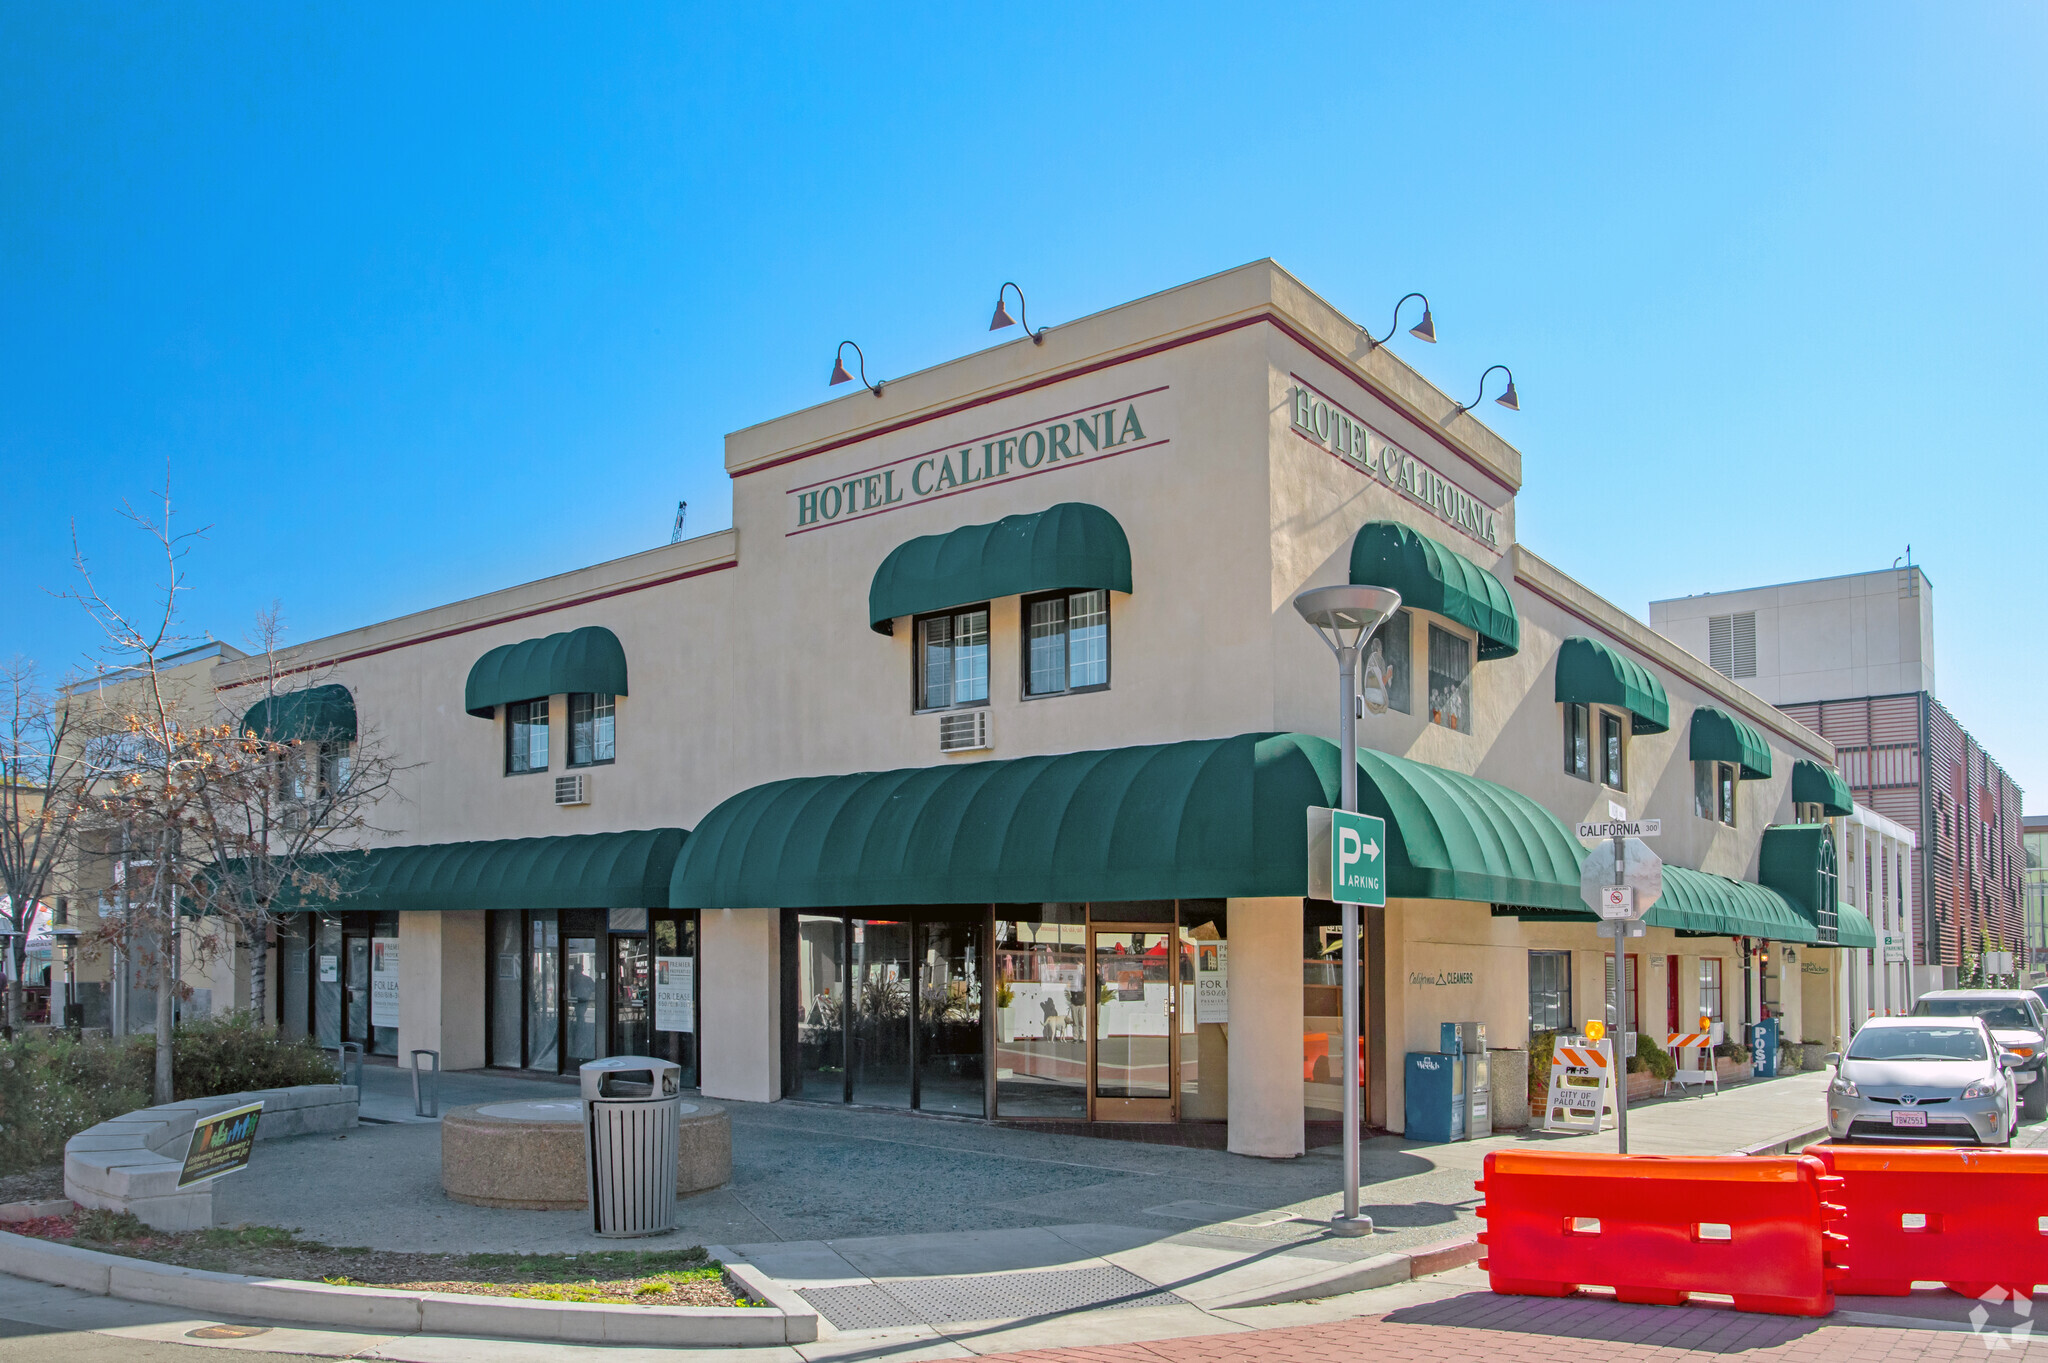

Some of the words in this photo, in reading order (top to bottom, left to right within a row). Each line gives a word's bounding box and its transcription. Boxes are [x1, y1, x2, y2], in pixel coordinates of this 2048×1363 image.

[797, 470, 903, 527] HOTEL
[911, 403, 1147, 497] CALIFORNIA
[1295, 385, 1378, 473] HOTEL
[1383, 444, 1499, 547] CALIFORNIA
[1580, 823, 1640, 837] CALIFORNIA
[1339, 826, 1379, 889] PARKING
[1200, 980, 1222, 989] FOR
[1447, 972, 1473, 984] CLEANERS
[374, 981, 386, 989] FOR
[387, 981, 399, 990] LEA
[658, 992, 670, 1000] FOR
[672, 993, 690, 1001] LEASE
[1755, 1027, 1767, 1071] POST
[1554, 1097, 1573, 1106] PALO
[1577, 1099, 1596, 1107] ALTO
